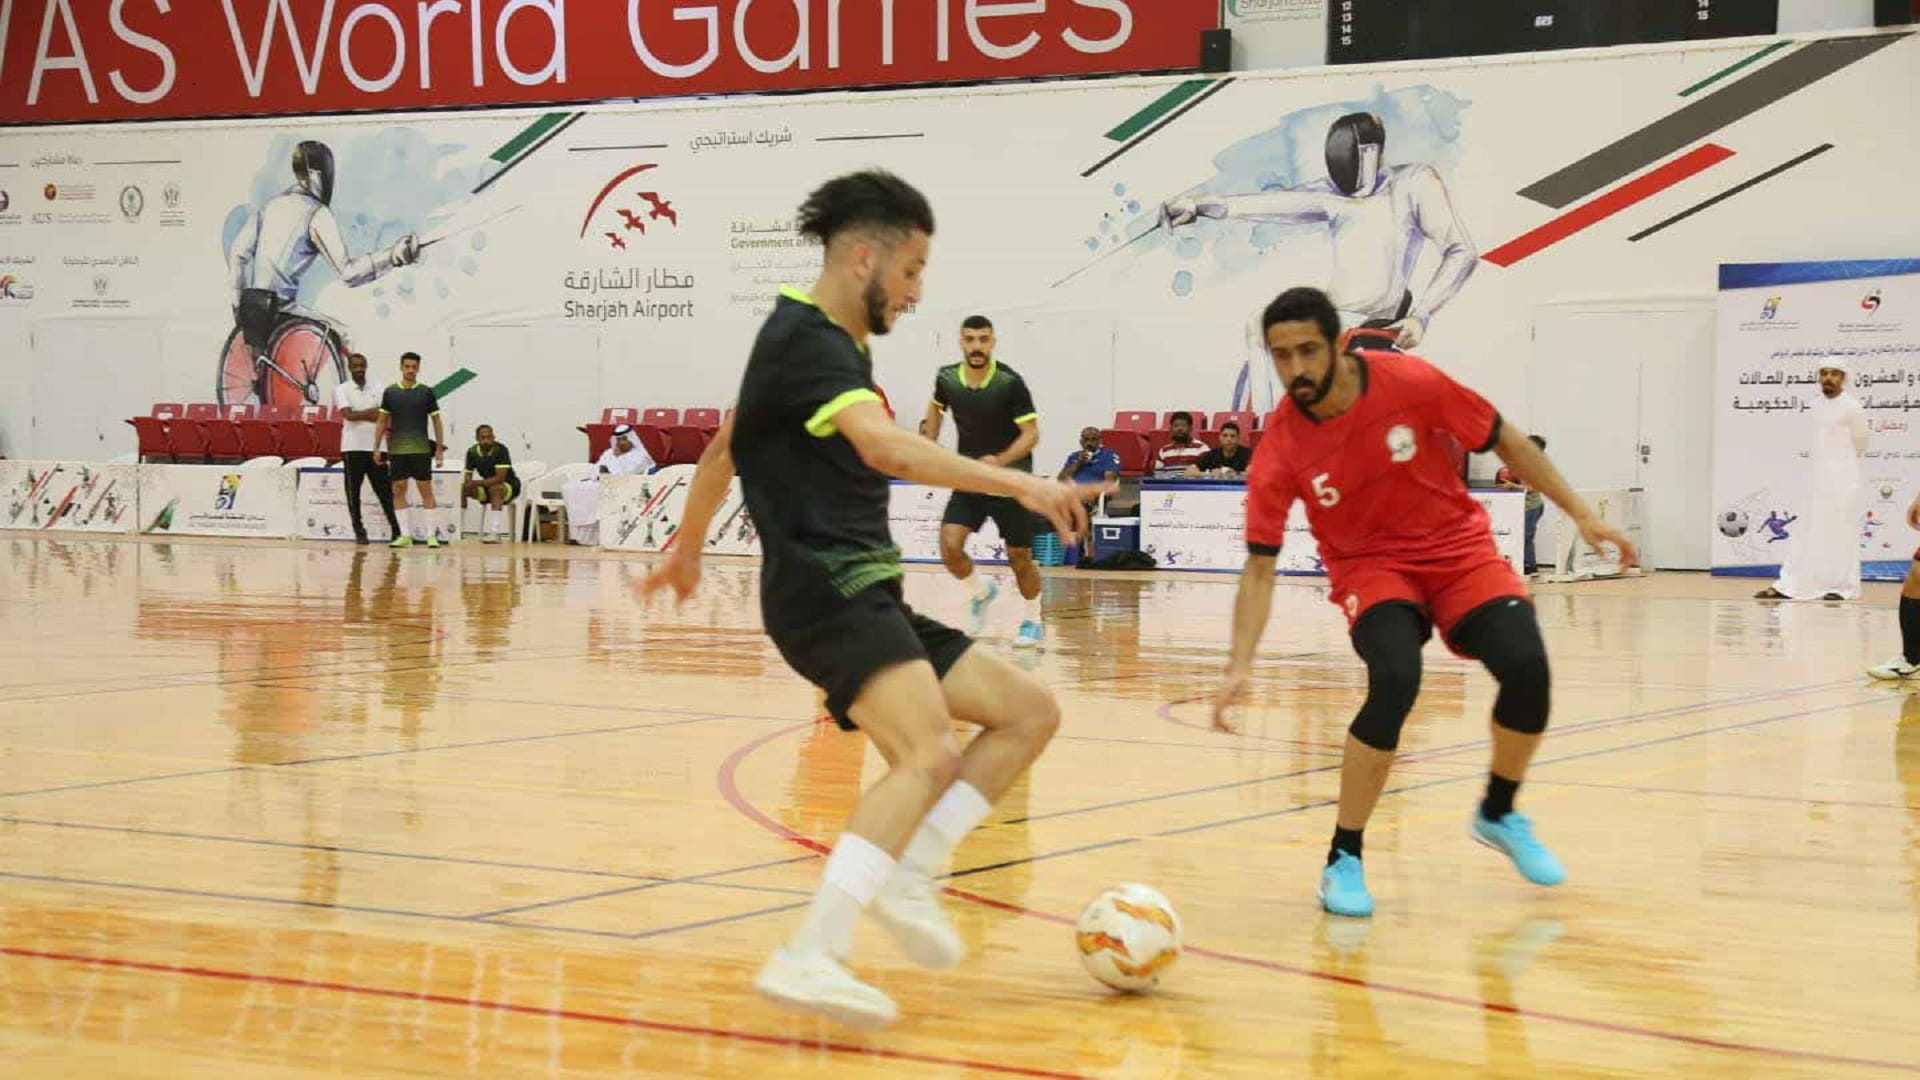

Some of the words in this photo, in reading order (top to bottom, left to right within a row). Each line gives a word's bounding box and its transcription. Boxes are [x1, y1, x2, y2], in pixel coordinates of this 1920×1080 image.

[1697, 10, 1709, 21] 15
[0, 0, 177, 105] AS
[222, 0, 567, 97] World
[627, 0, 1133, 79] Games
[690, 130, 753, 153] استراتيجي
[755, 125, 792, 147] شريك
[731, 238, 793, 249] Government
[564, 266, 640, 294] الشارقة
[645, 267, 694, 294] مطار
[564, 299, 628, 322] Sharjah
[632, 299, 694, 322] Airport
[1785, 370, 1818, 388] لقدم
[1855, 369, 1904, 387] العشرون
[1732, 395, 1798, 414] الحكومية
[1311, 472, 1341, 507] 5
